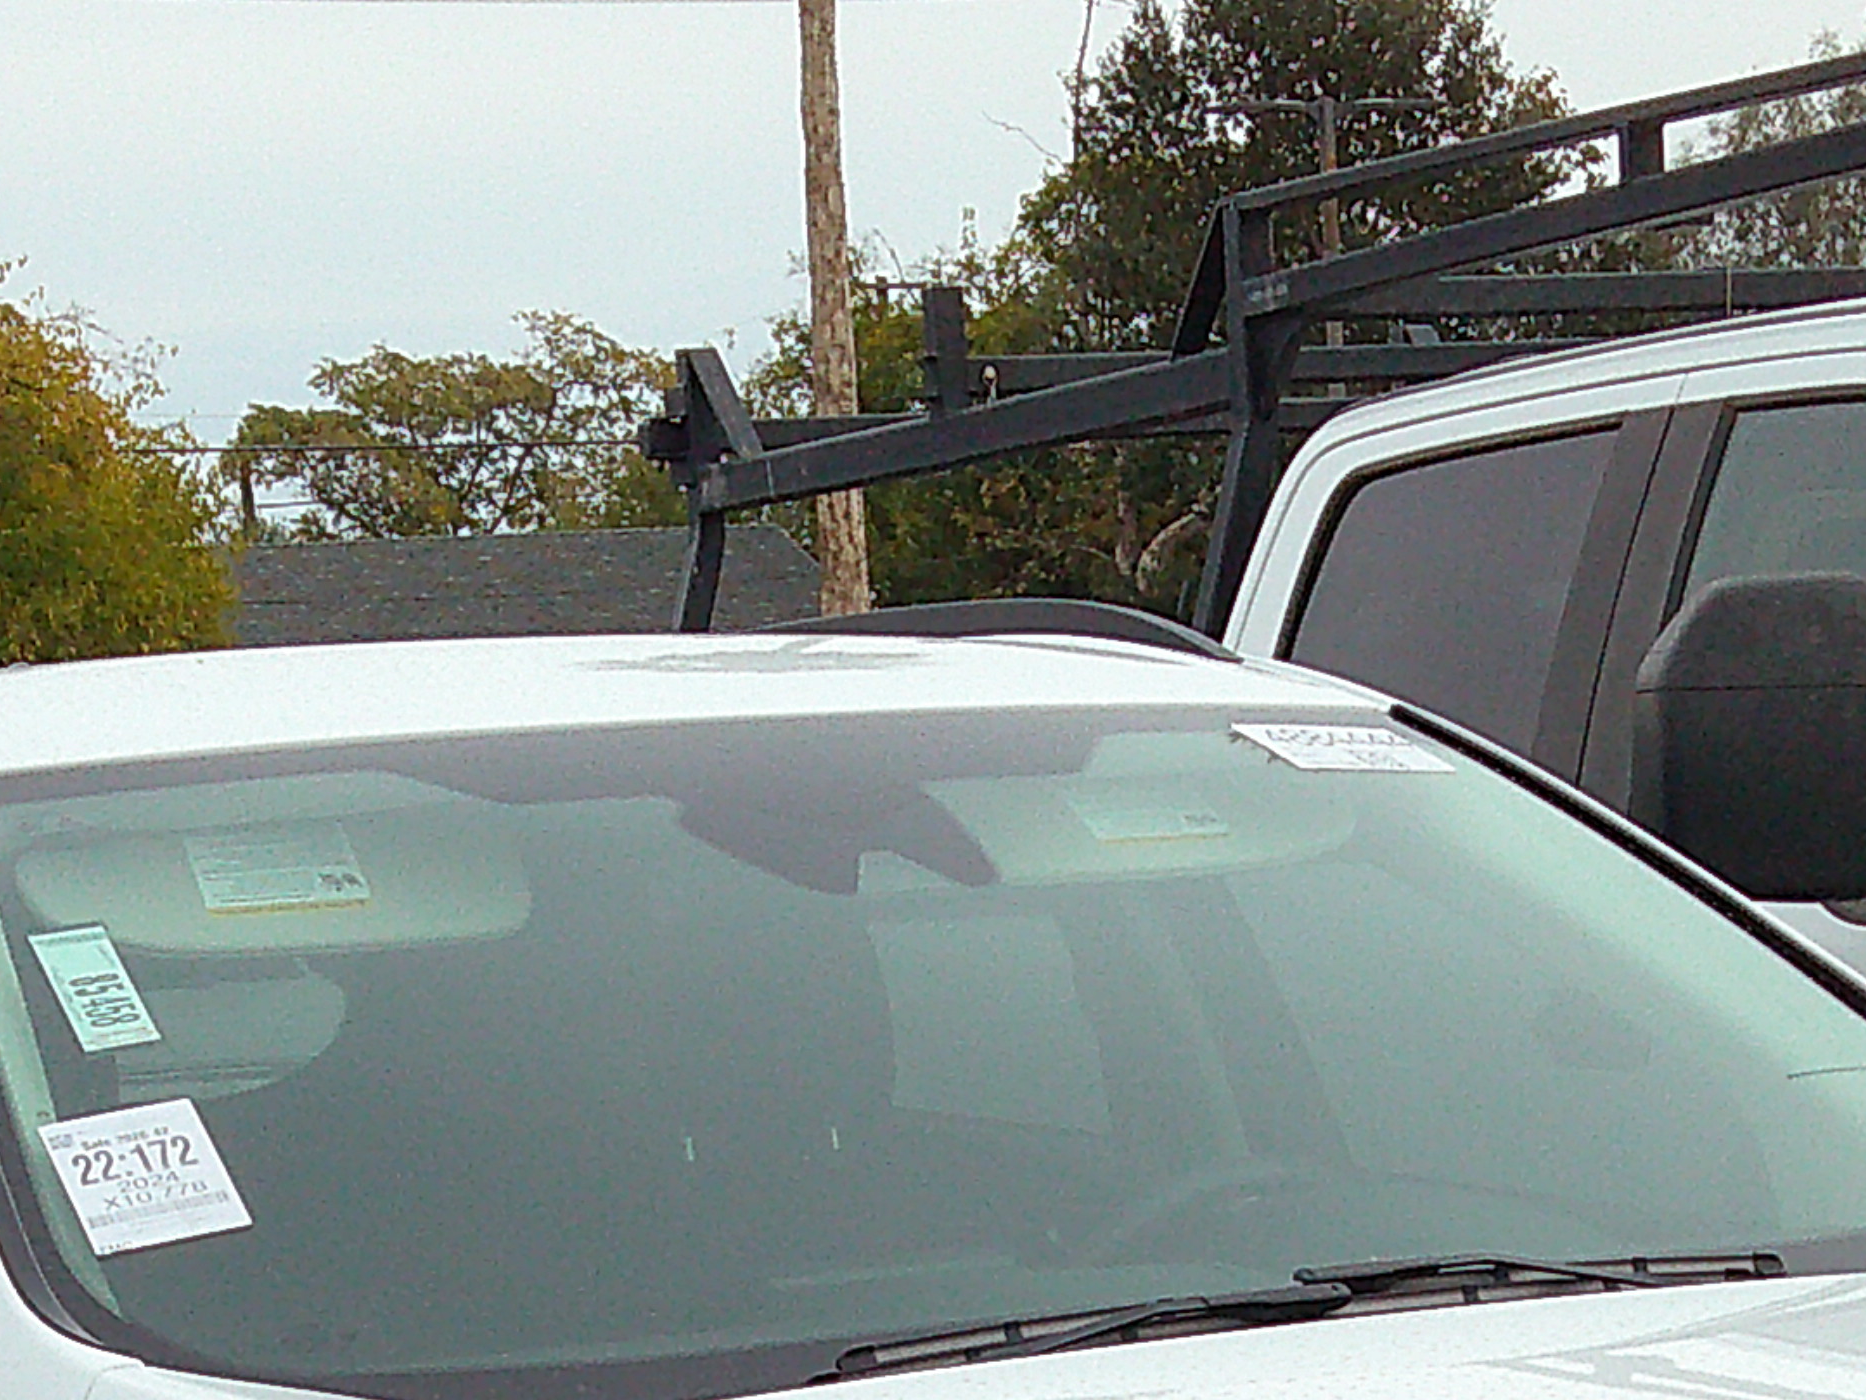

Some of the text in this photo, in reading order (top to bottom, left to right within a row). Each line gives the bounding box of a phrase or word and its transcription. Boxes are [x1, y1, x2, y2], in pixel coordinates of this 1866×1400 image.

[67, 972, 142, 1028] 85458
[71, 1134, 200, 1187] 22:172
[116, 1170, 181, 1195] 2024
